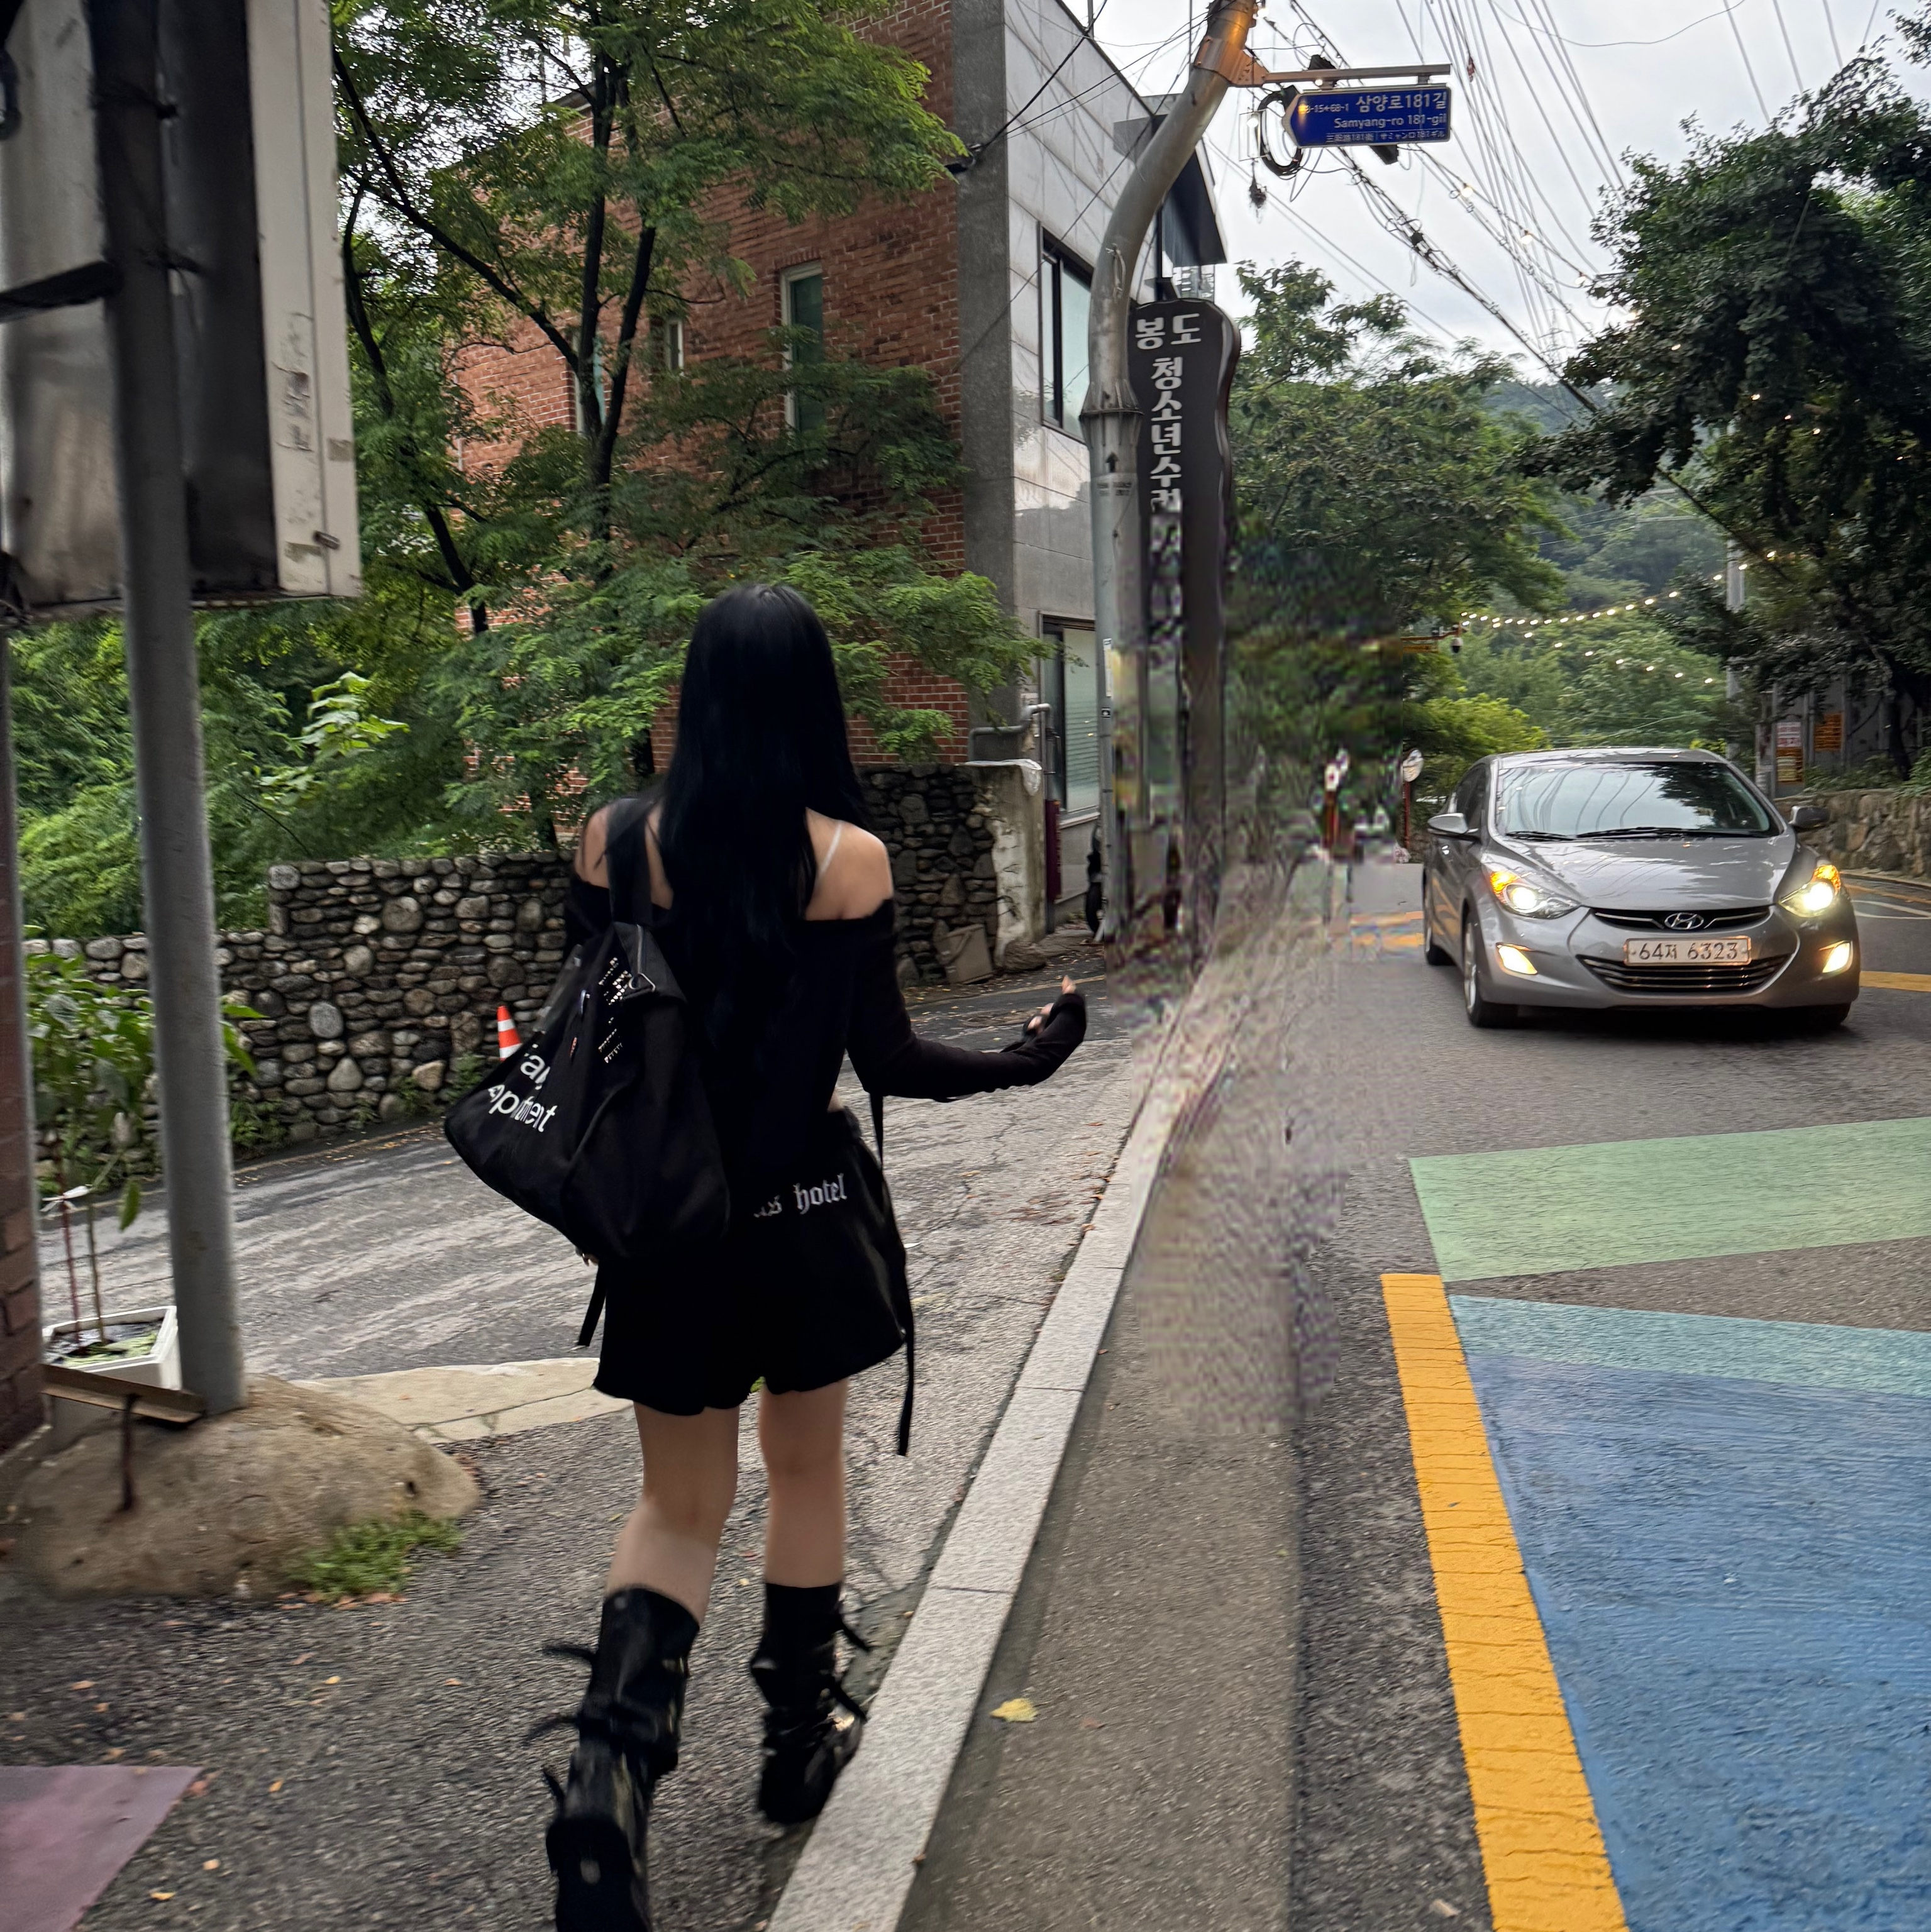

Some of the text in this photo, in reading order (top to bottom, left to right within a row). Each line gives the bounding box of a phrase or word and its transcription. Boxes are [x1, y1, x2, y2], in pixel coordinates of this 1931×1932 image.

[1356, 92, 1446, 113] 삼양로181길
[1334, 113, 1446, 129] Samyang-ro 181-gil
[1136, 313, 1202, 350] 봉도
[1639, 942, 1738, 960] 64저 6323
[793, 1173, 848, 1215] hotel
